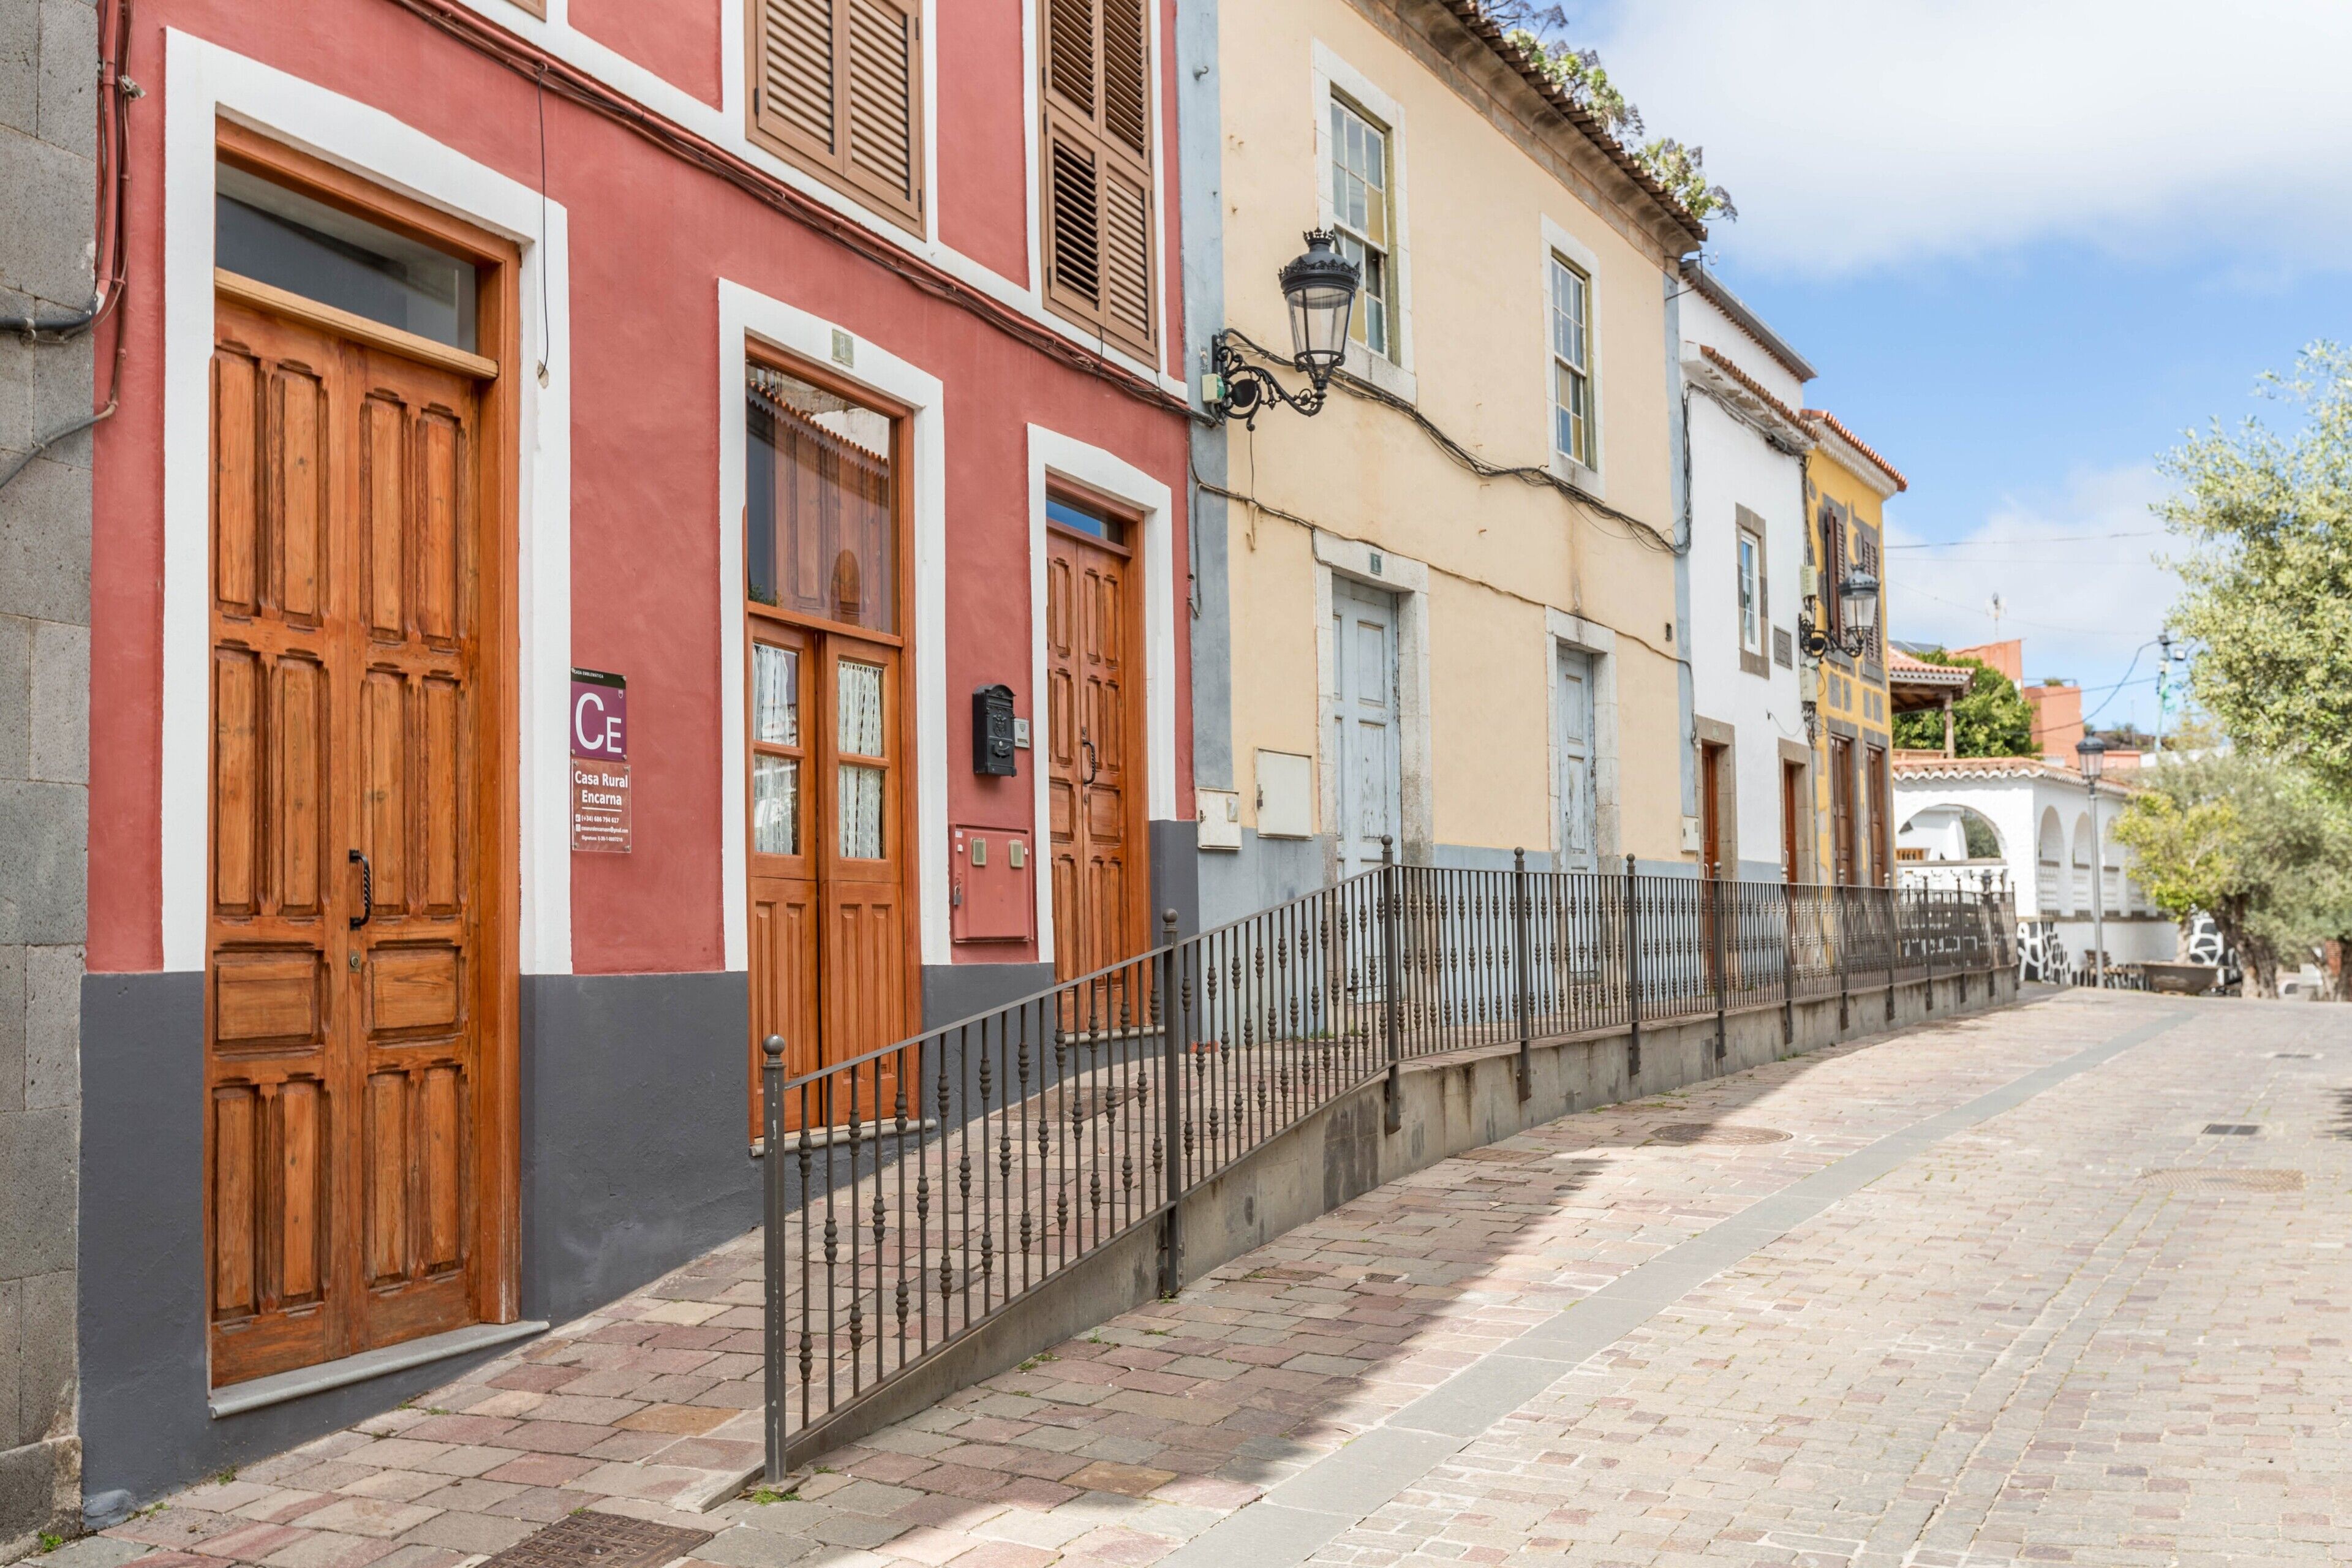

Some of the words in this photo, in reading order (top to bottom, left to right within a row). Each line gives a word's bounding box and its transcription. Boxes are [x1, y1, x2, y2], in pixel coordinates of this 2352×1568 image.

[575, 771, 599, 786] Casa
[602, 773, 628, 788] Rural
[582, 790, 622, 806] Encarna
